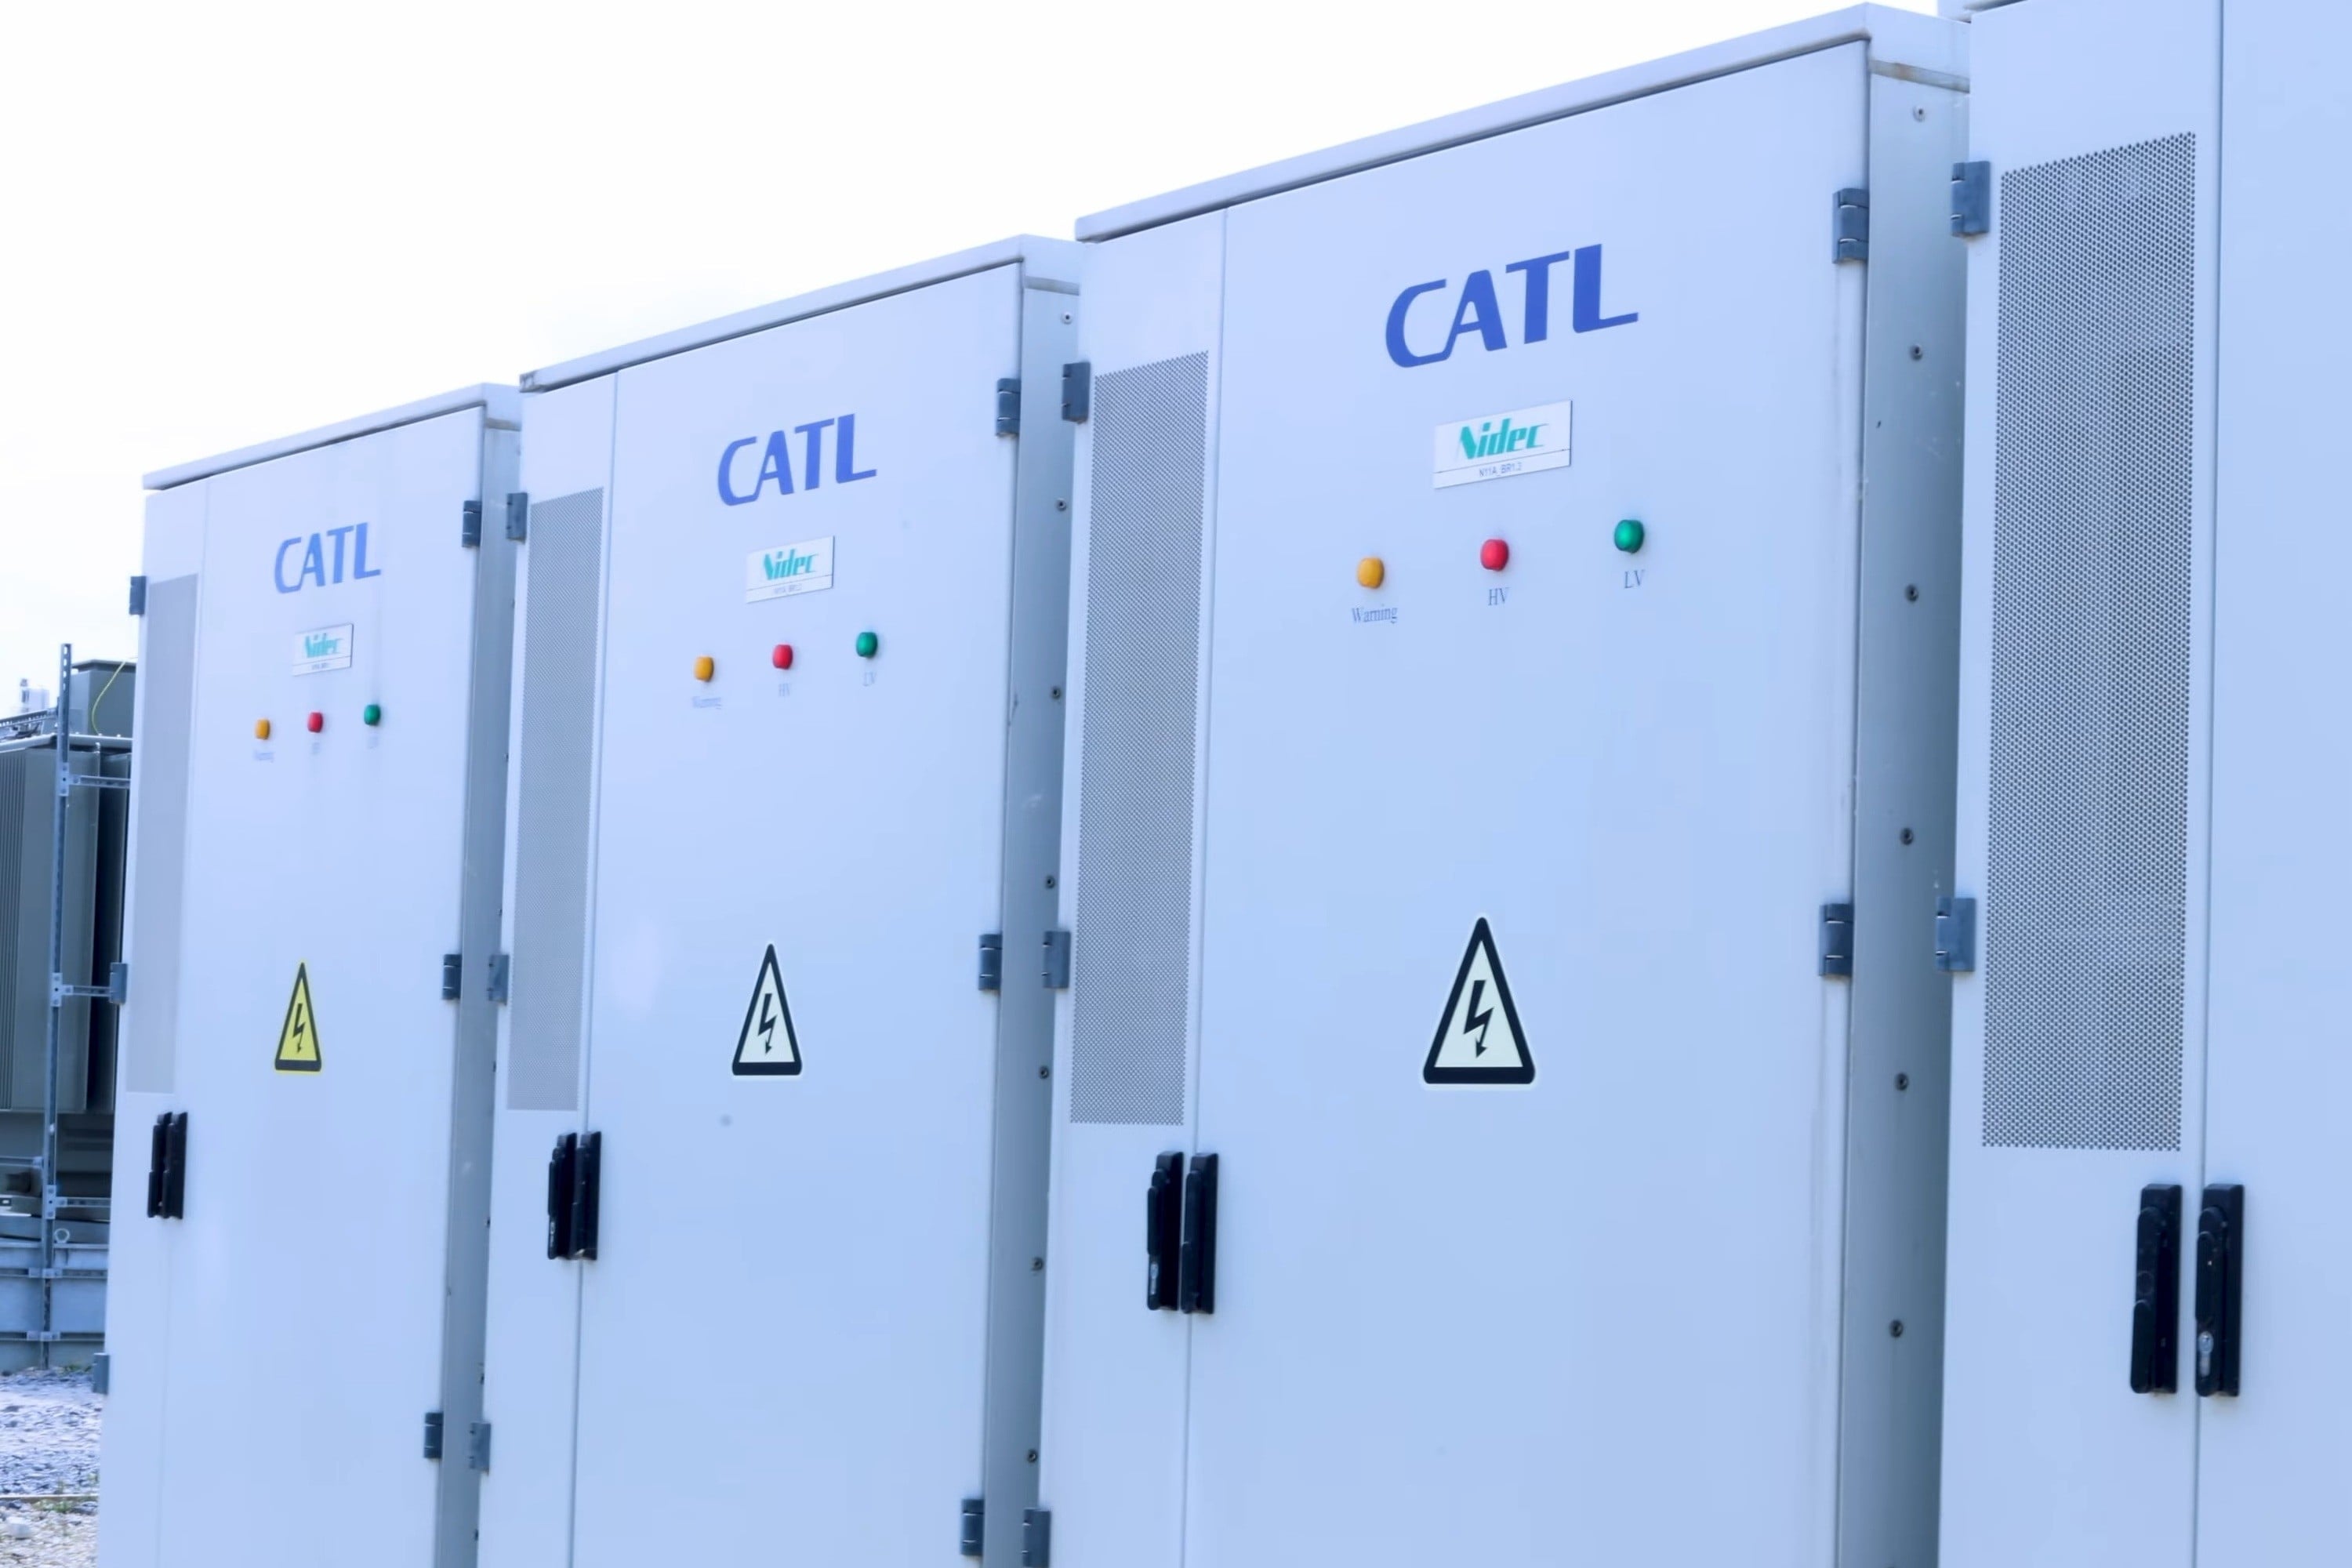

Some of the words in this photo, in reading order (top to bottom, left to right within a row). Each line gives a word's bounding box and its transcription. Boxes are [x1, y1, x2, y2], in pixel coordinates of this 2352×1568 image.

[1385, 244, 1639, 368] CATL
[1457, 418, 1549, 459] Nidec
[717, 413, 877, 506] CATL
[274, 522, 381, 594] CATL
[763, 549, 818, 580] Nidec
[1487, 586, 1510, 606] HV
[1624, 569, 1645, 589] LV
[1352, 603, 1398, 624] Warning
